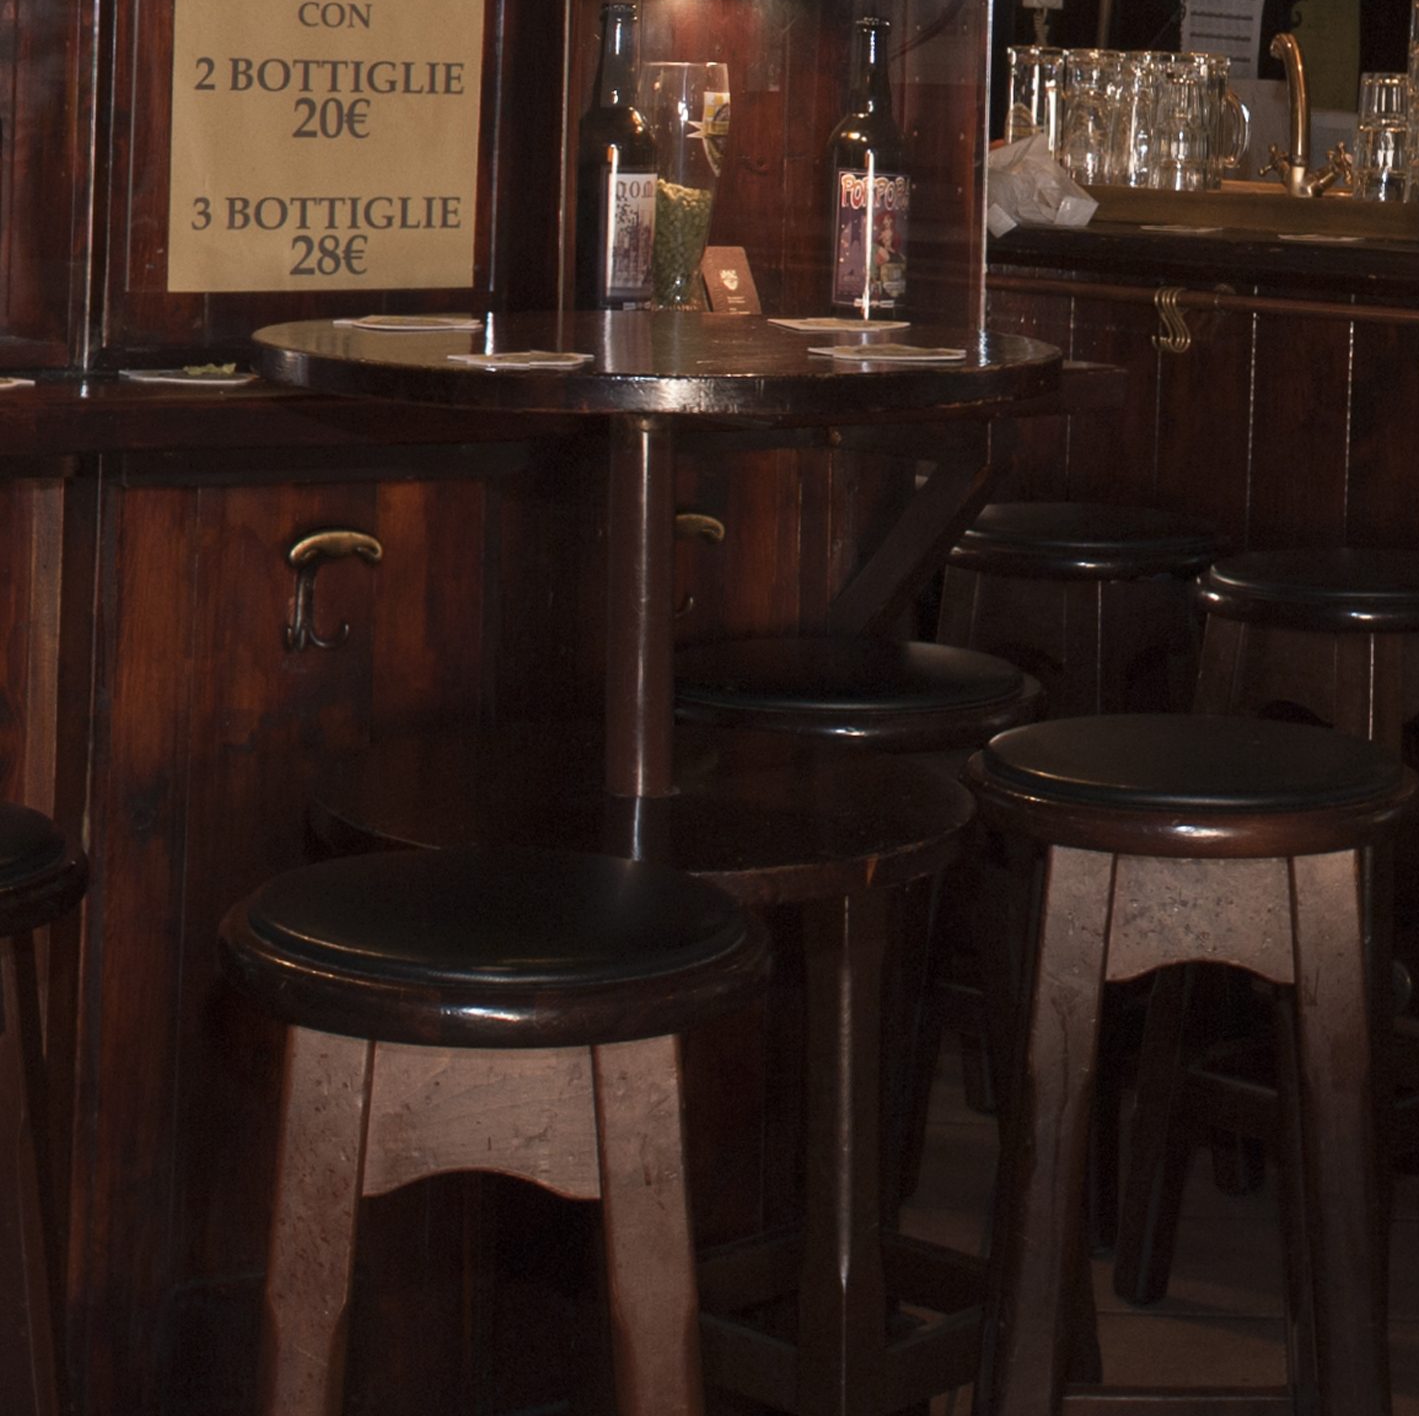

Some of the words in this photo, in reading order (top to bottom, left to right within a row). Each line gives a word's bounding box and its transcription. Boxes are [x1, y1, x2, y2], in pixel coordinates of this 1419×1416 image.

[298, 1, 372, 29] CON
[194, 57, 216, 91] 2
[229, 57, 465, 95] BOTTIGLIE
[292, 98, 371, 139] 20€
[191, 196, 213, 231] 3
[226, 196, 462, 230] BOTTIGLIE
[289, 235, 368, 276] 28€
